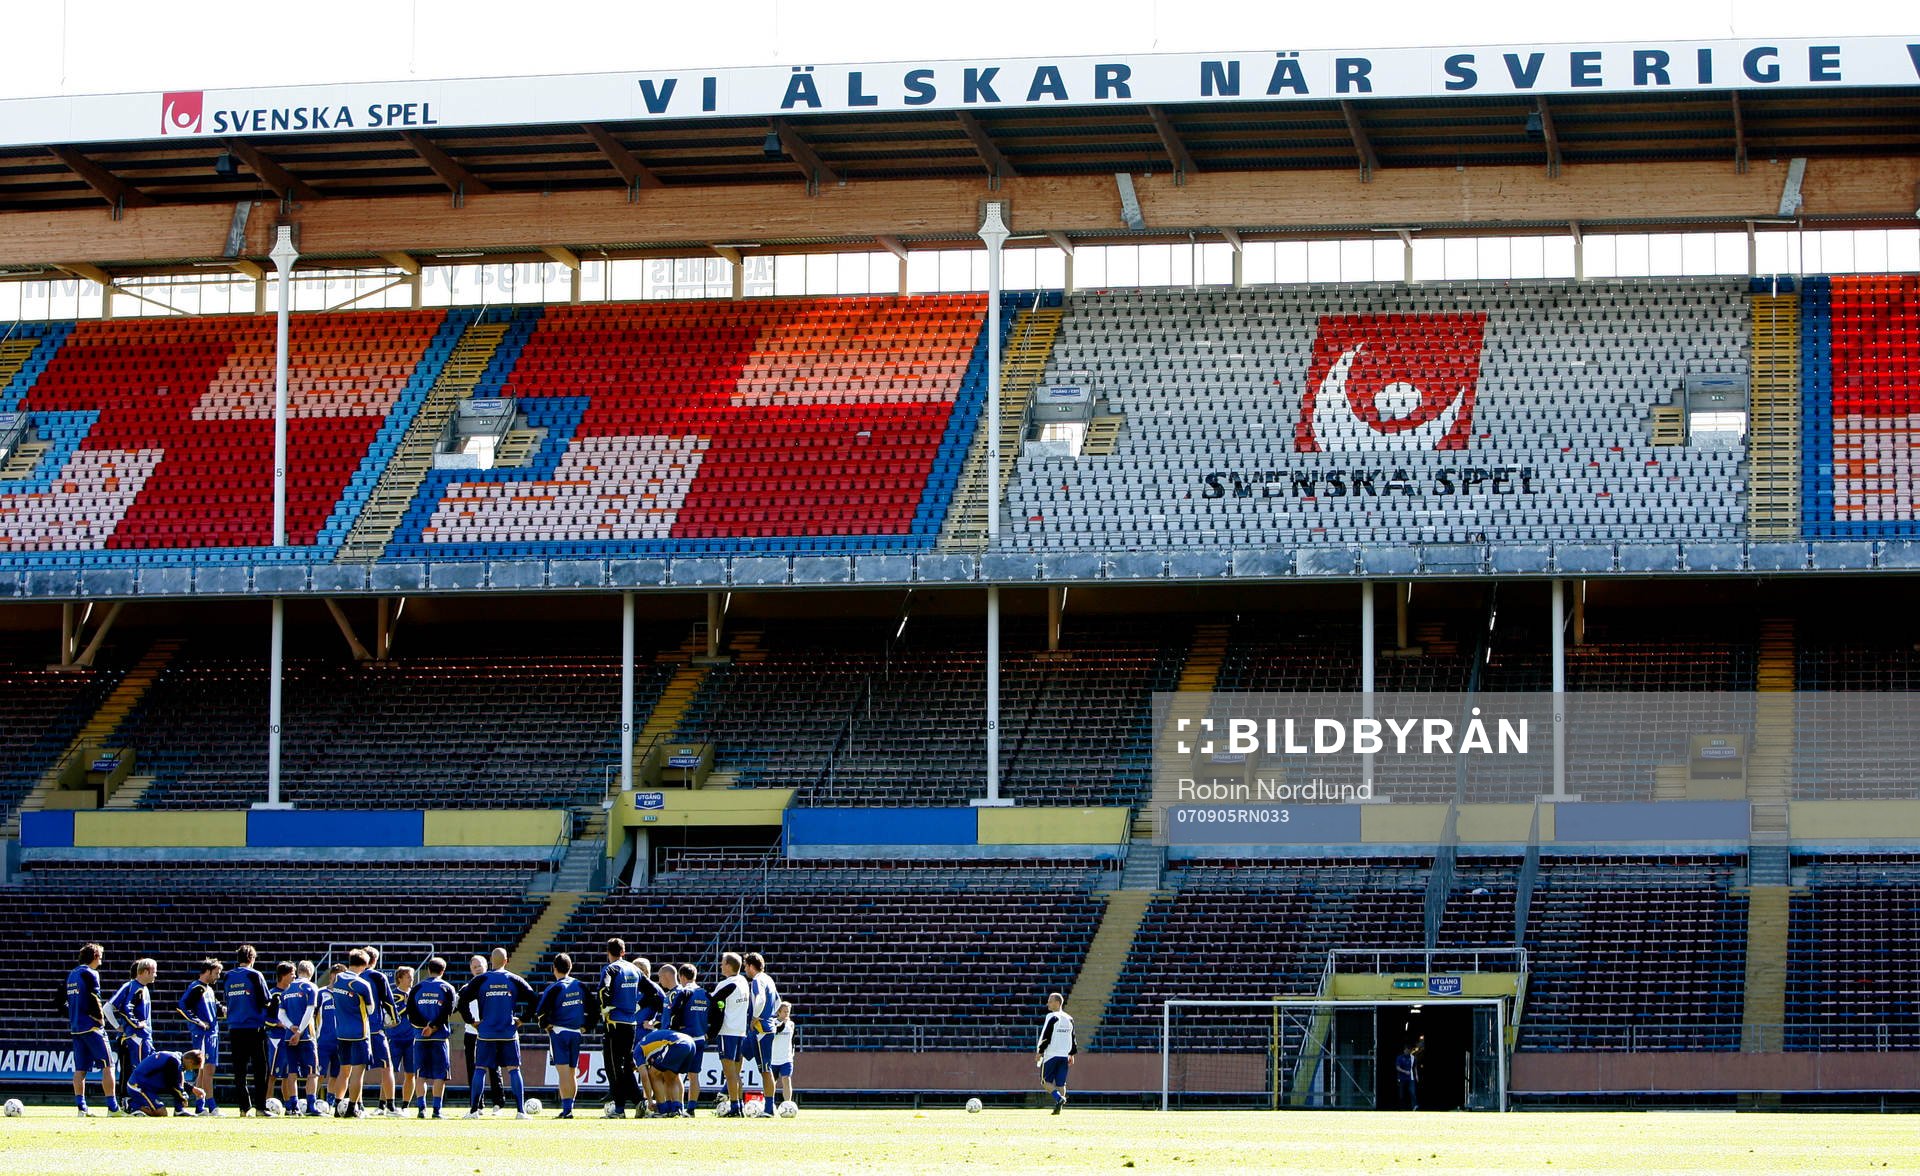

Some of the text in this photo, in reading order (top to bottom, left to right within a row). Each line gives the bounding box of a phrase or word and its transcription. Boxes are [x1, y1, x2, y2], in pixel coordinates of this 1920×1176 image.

[638, 46, 1841, 114] VI ÄLSKAR NÄR SVERIGE
[213, 102, 438, 133] SVENSKA SPEL
[276, 467, 283, 477] 5
[1202, 467, 1538, 499] SVENSKA SPEL
[623, 722, 630, 732] 9
[989, 720, 996, 730] 8
[1431, 976, 1458, 985] UTGÅNG
[0, 1050, 76, 1073] ATIONA
